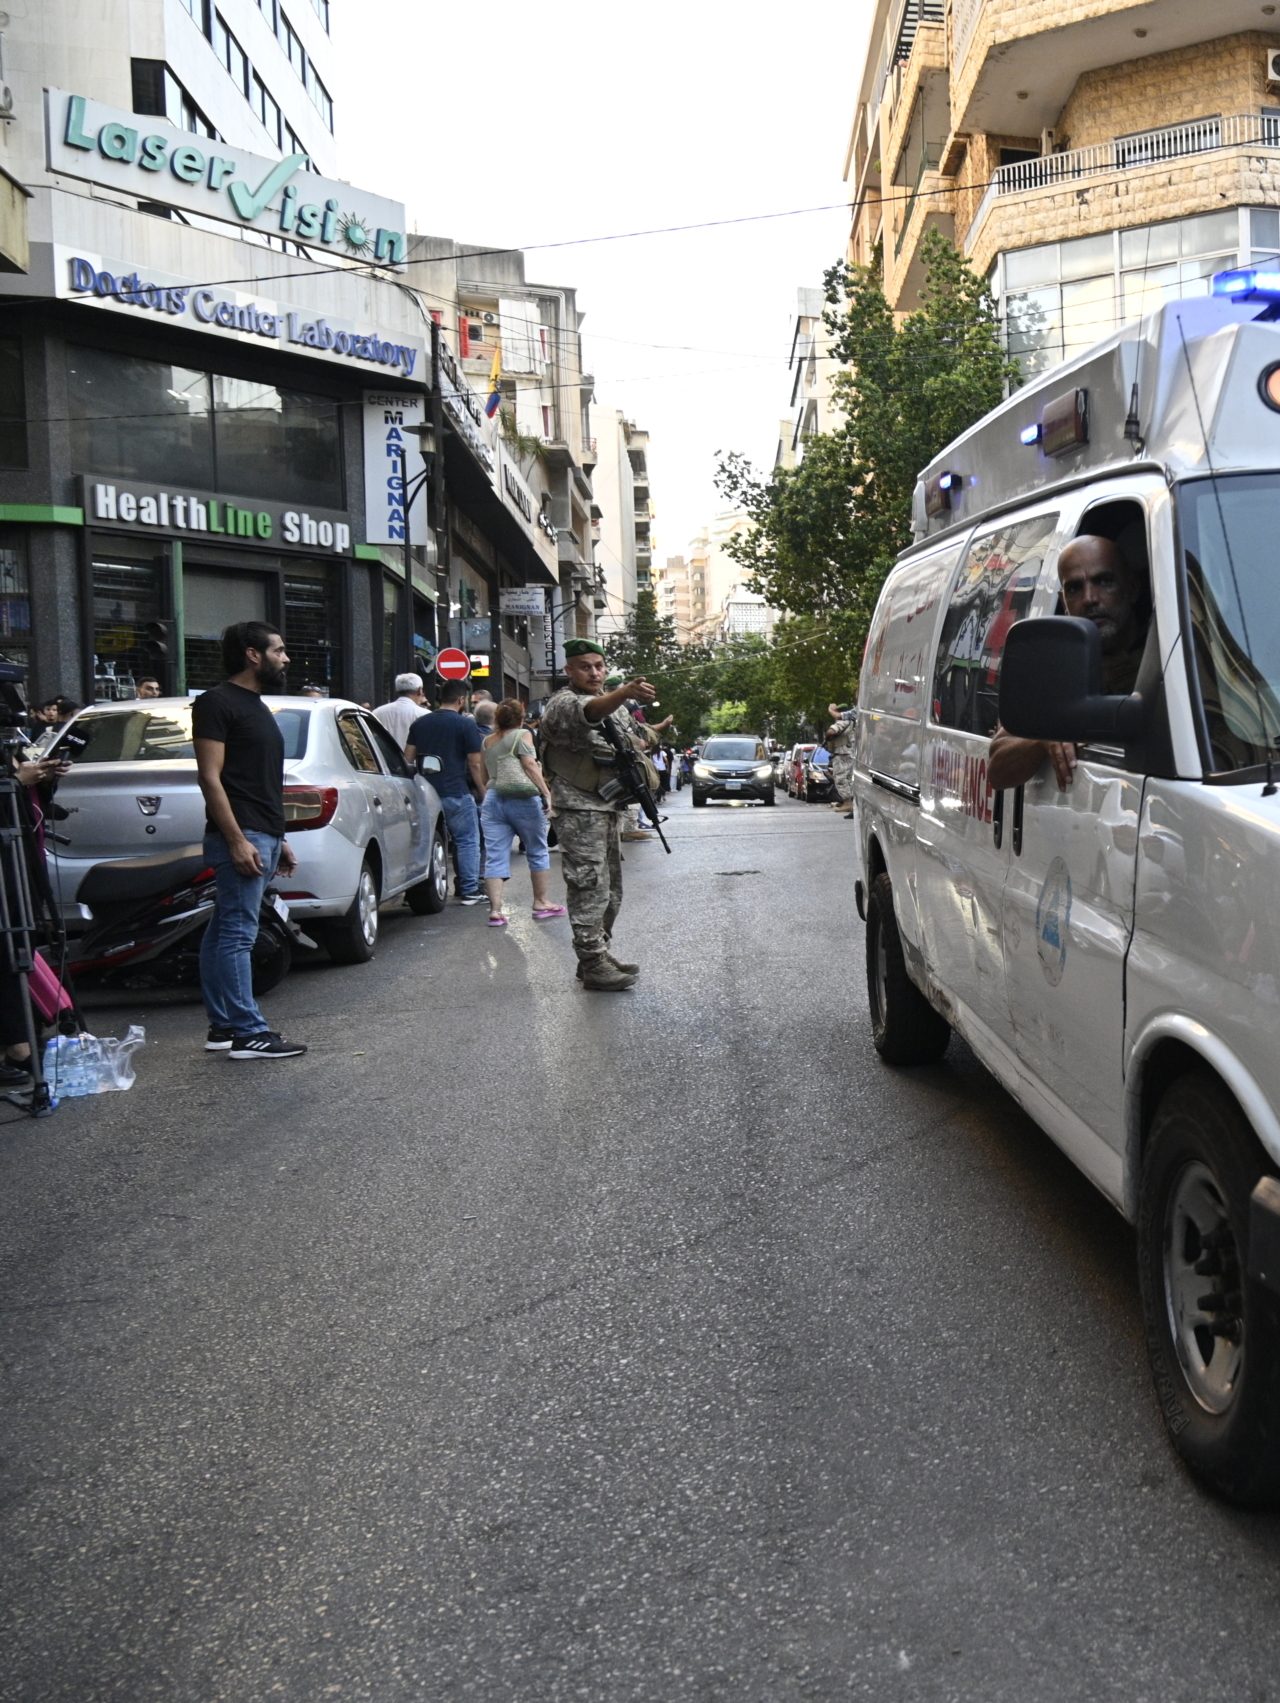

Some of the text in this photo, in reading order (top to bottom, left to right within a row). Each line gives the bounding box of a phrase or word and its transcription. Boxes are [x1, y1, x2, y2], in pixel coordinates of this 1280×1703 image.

[64, 94, 235, 190] Laser
[194, 290, 283, 339] Center
[288, 311, 417, 376] Laboratory
[368, 395, 418, 408] CENTER
[95, 483, 351, 553] HealthLine Shop
[384, 411, 405, 539] MARIGNAN
